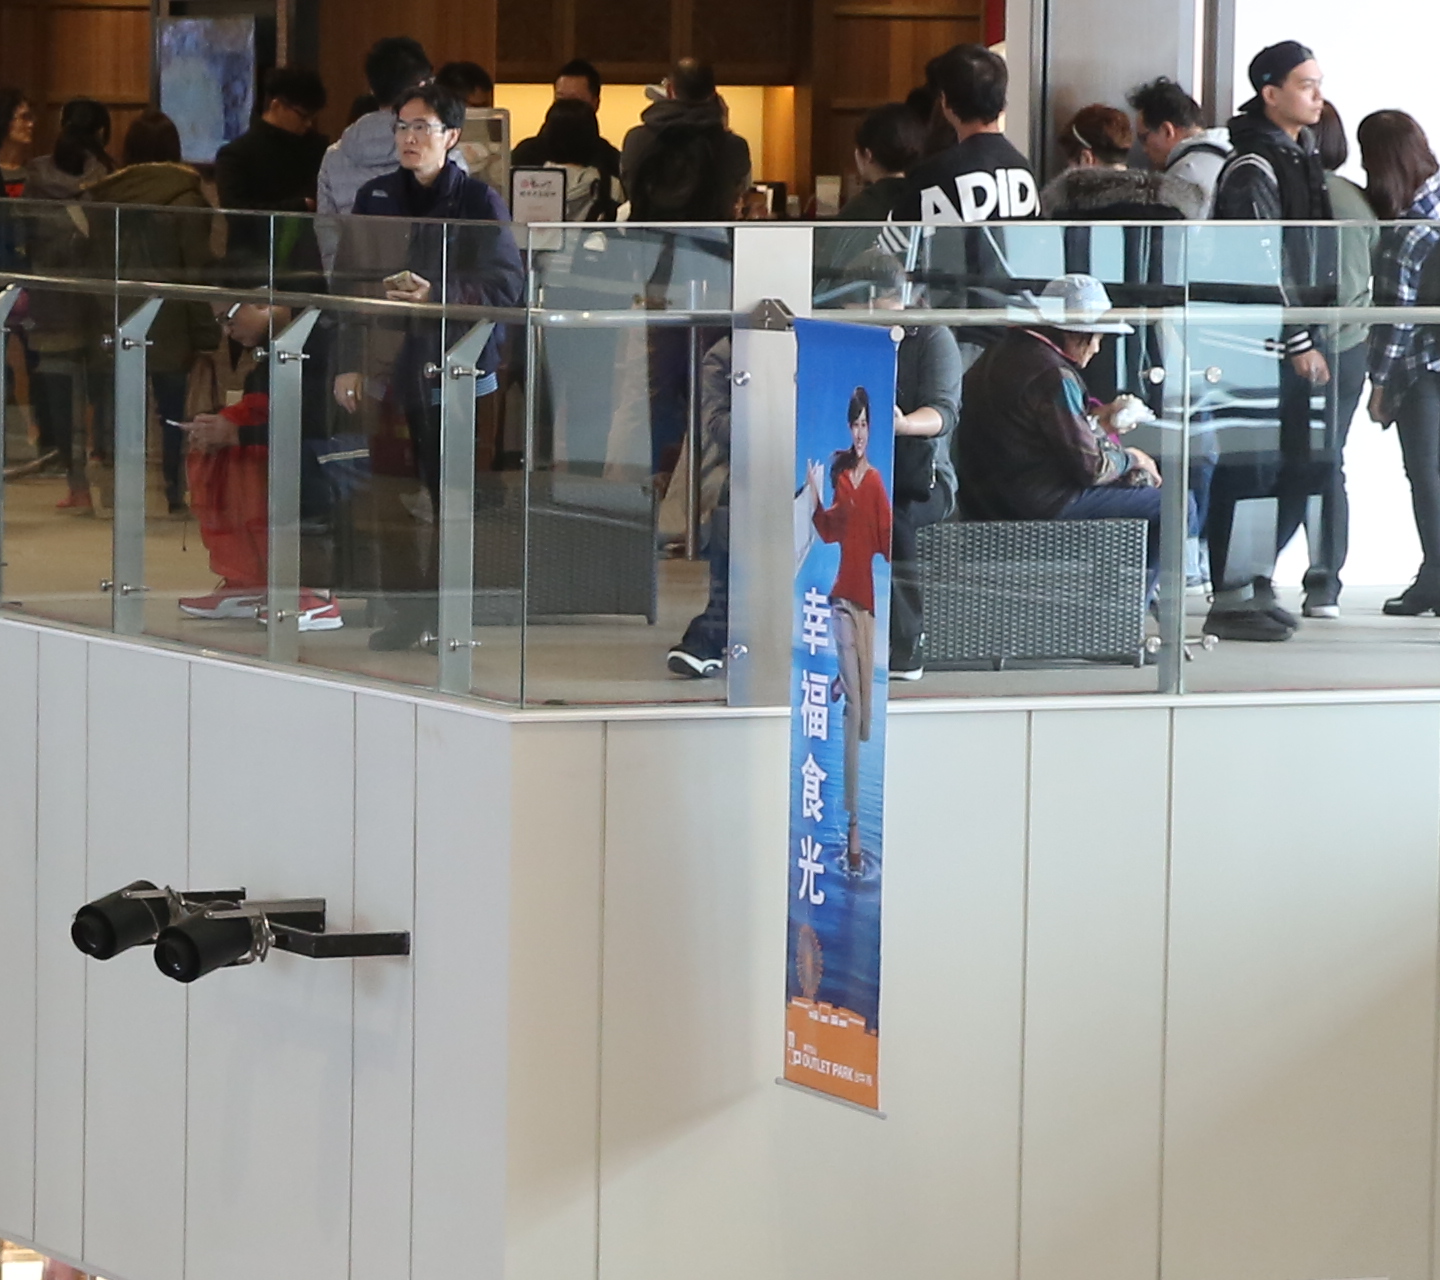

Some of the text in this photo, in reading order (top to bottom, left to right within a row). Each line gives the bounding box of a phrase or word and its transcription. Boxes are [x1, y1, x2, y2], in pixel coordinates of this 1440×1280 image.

[920, 167, 1041, 224] ADID
[797, 586, 833, 906] 幸福食光
[802, 1053, 831, 1075] OUTLET
[832, 1062, 854, 1081] PARK
